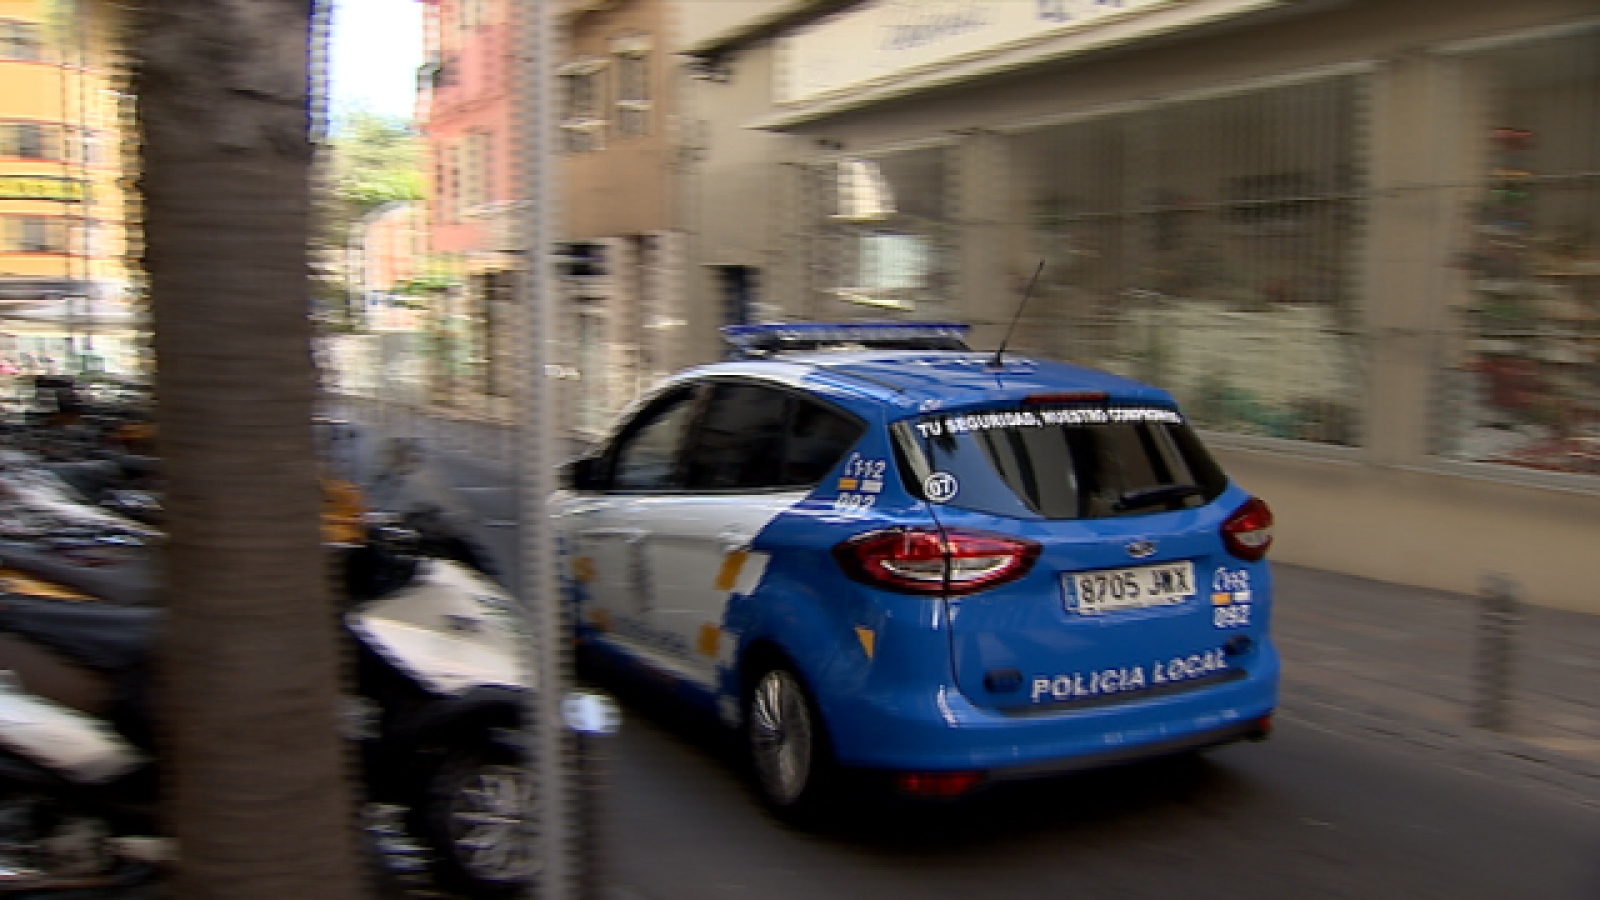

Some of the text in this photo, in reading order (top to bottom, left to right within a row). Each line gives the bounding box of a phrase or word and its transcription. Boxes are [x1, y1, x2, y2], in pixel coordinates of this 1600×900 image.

[915, 420, 942, 438] TU
[1079, 571, 1140, 604] 8705
[1031, 647, 1228, 702] POLICIA LOCAL
